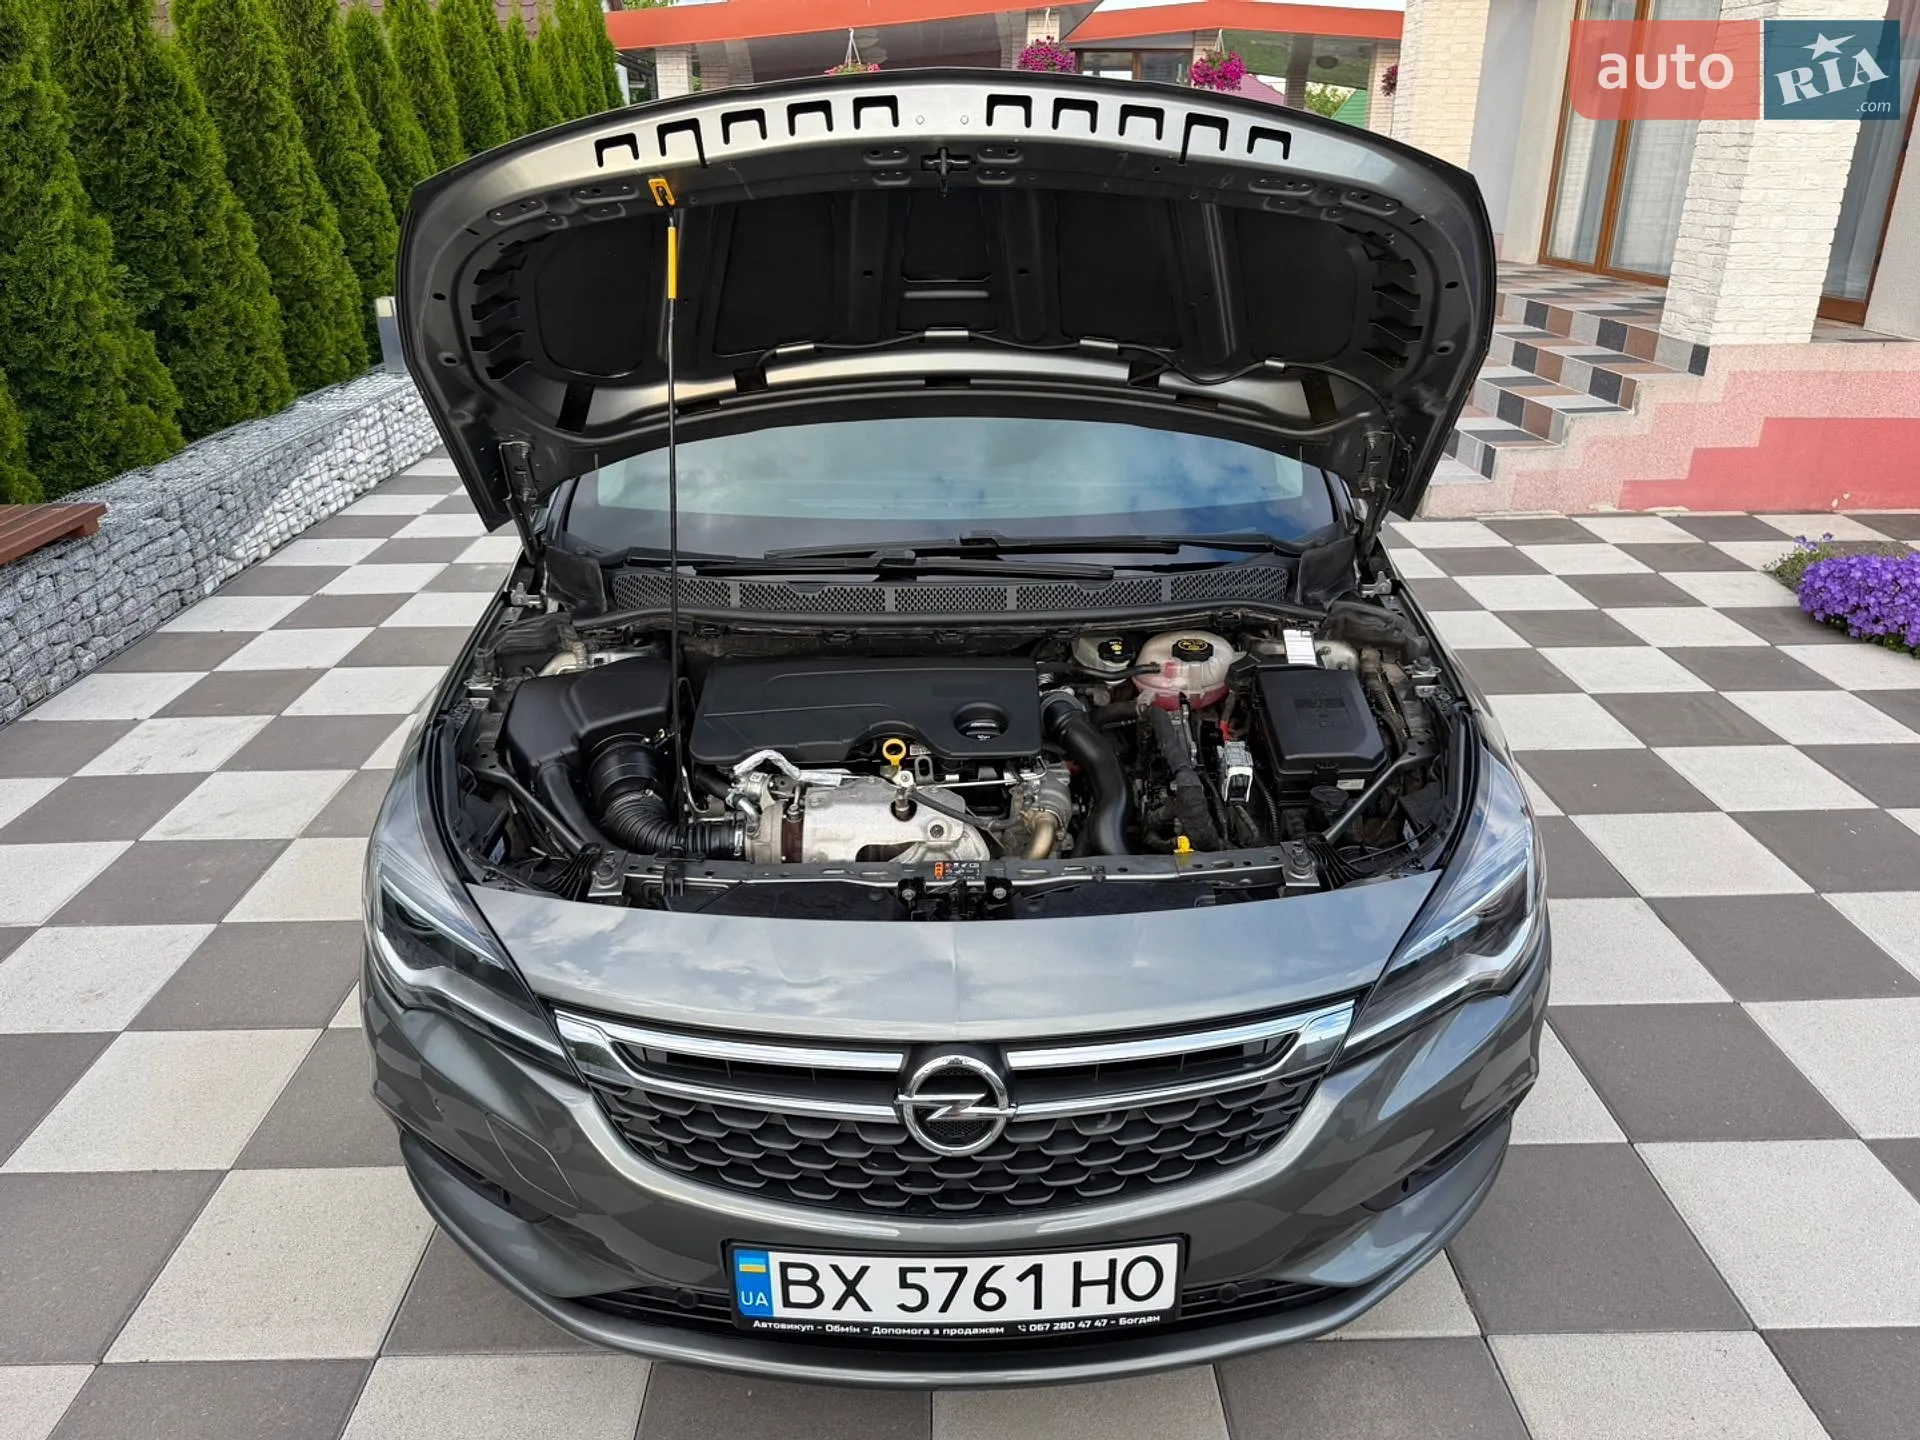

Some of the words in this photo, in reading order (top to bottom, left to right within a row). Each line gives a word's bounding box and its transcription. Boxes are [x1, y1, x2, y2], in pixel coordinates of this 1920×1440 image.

[779, 1261, 872, 1313] BX
[897, 1263, 1043, 1313] 5761
[1071, 1254, 1164, 1308] HO
[741, 1290, 769, 1307] UA
[753, 1320, 814, 1332] Автовикуп
[825, 1324, 860, 1333] Обмін
[872, 1327, 930, 1335] Допомога
[943, 1327, 1005, 1336] продажем
[1029, 1323, 1050, 1332] 067
[1053, 1321, 1075, 1330] 280
[1078, 1320, 1091, 1328] 47
[1094, 1319, 1108, 1327] 47
[1119, 1316, 1160, 1325] Богдан
